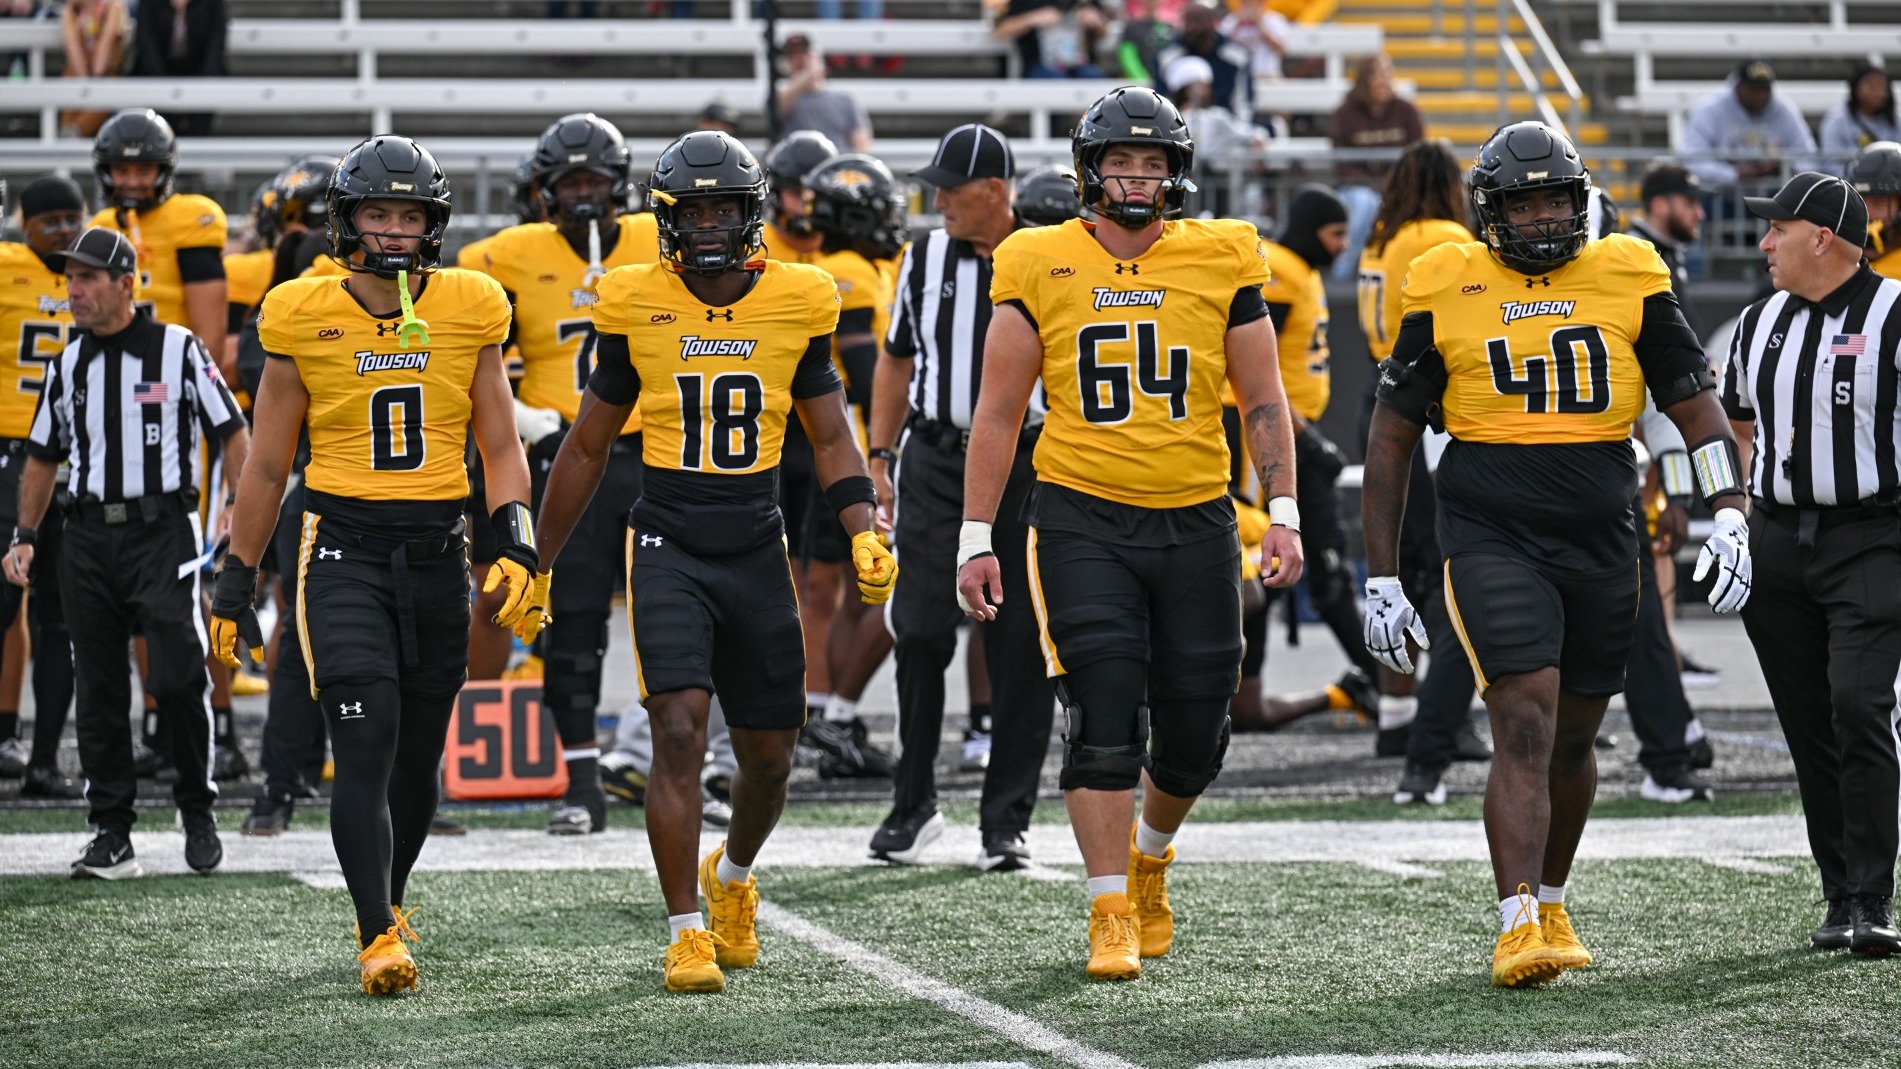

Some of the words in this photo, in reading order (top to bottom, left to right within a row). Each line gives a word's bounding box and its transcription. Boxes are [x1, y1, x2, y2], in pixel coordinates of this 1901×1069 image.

[1051, 267, 1071, 276] CAA
[942, 281, 955, 298] S
[1461, 284, 1483, 293] CAA
[651, 314, 672, 323] CAA
[318, 328, 340, 338] CAA
[1768, 332, 1784, 349] S
[556, 319, 598, 394] 7
[1076, 320, 1191, 426] 64
[1485, 325, 1613, 414] 40
[1835, 381, 1850, 405] S
[369, 383, 426, 472] 0
[673, 371, 765, 472] 18
[145, 423, 160, 445] B
[458, 688, 557, 779] 50
